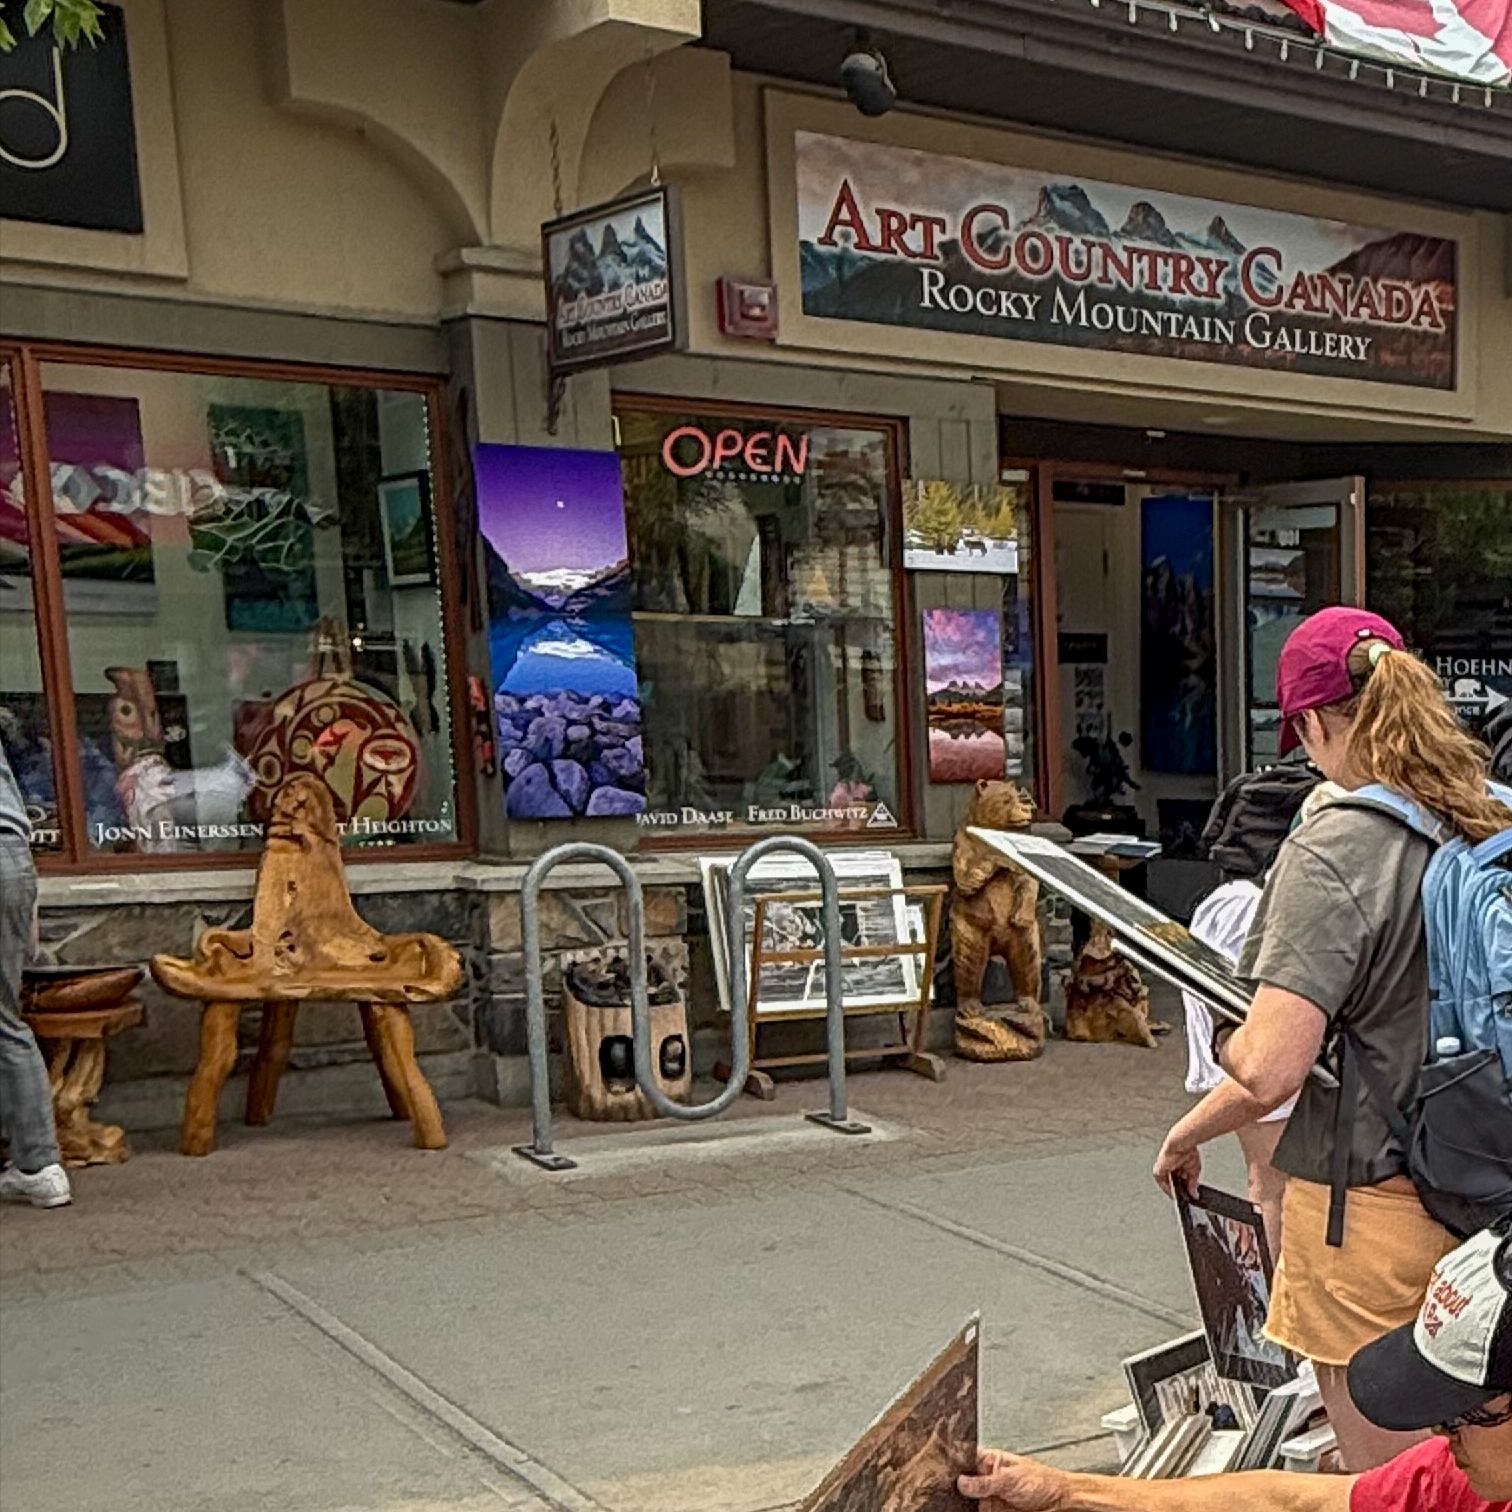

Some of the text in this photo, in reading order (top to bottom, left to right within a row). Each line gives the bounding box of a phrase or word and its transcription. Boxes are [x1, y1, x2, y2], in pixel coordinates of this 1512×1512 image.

[817, 178, 1446, 330] ART COUNTRY CANADA
[918, 267, 1372, 361] ROCKY MOUNTAIN GALLERY
[662, 425, 809, 477] OPEN
[350, 816, 453, 835] HEIGHTON
[748, 804, 788, 822] FRED
[95, 820, 265, 845] JONN EINERSSEN
